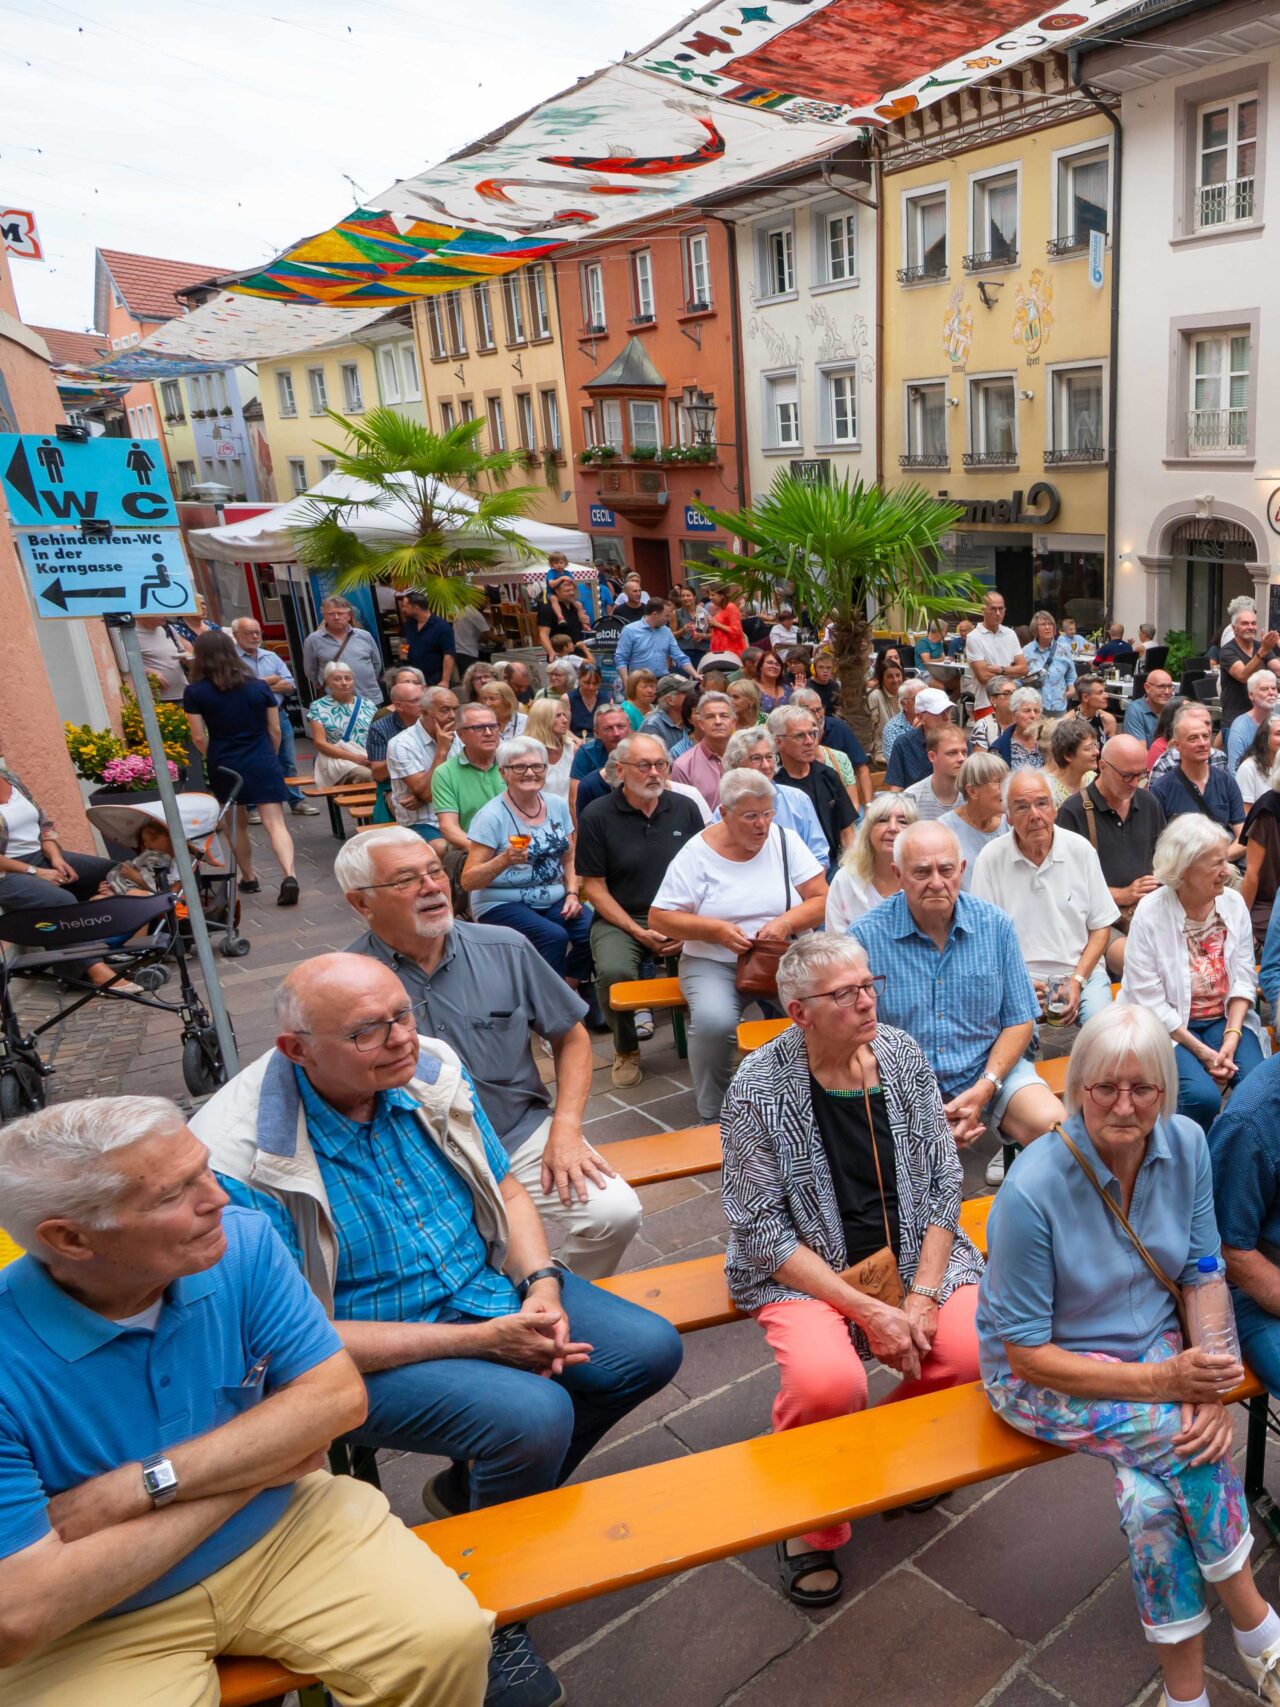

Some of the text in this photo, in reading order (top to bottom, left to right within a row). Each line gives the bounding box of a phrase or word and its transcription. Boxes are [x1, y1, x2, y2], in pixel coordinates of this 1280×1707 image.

[591, 509, 612, 522] CECIL
[27, 533, 163, 547] Behinderten-WC
[31, 547, 83, 561] in der
[36, 562, 123, 576] Korngasse
[59, 914, 113, 930] helavo
